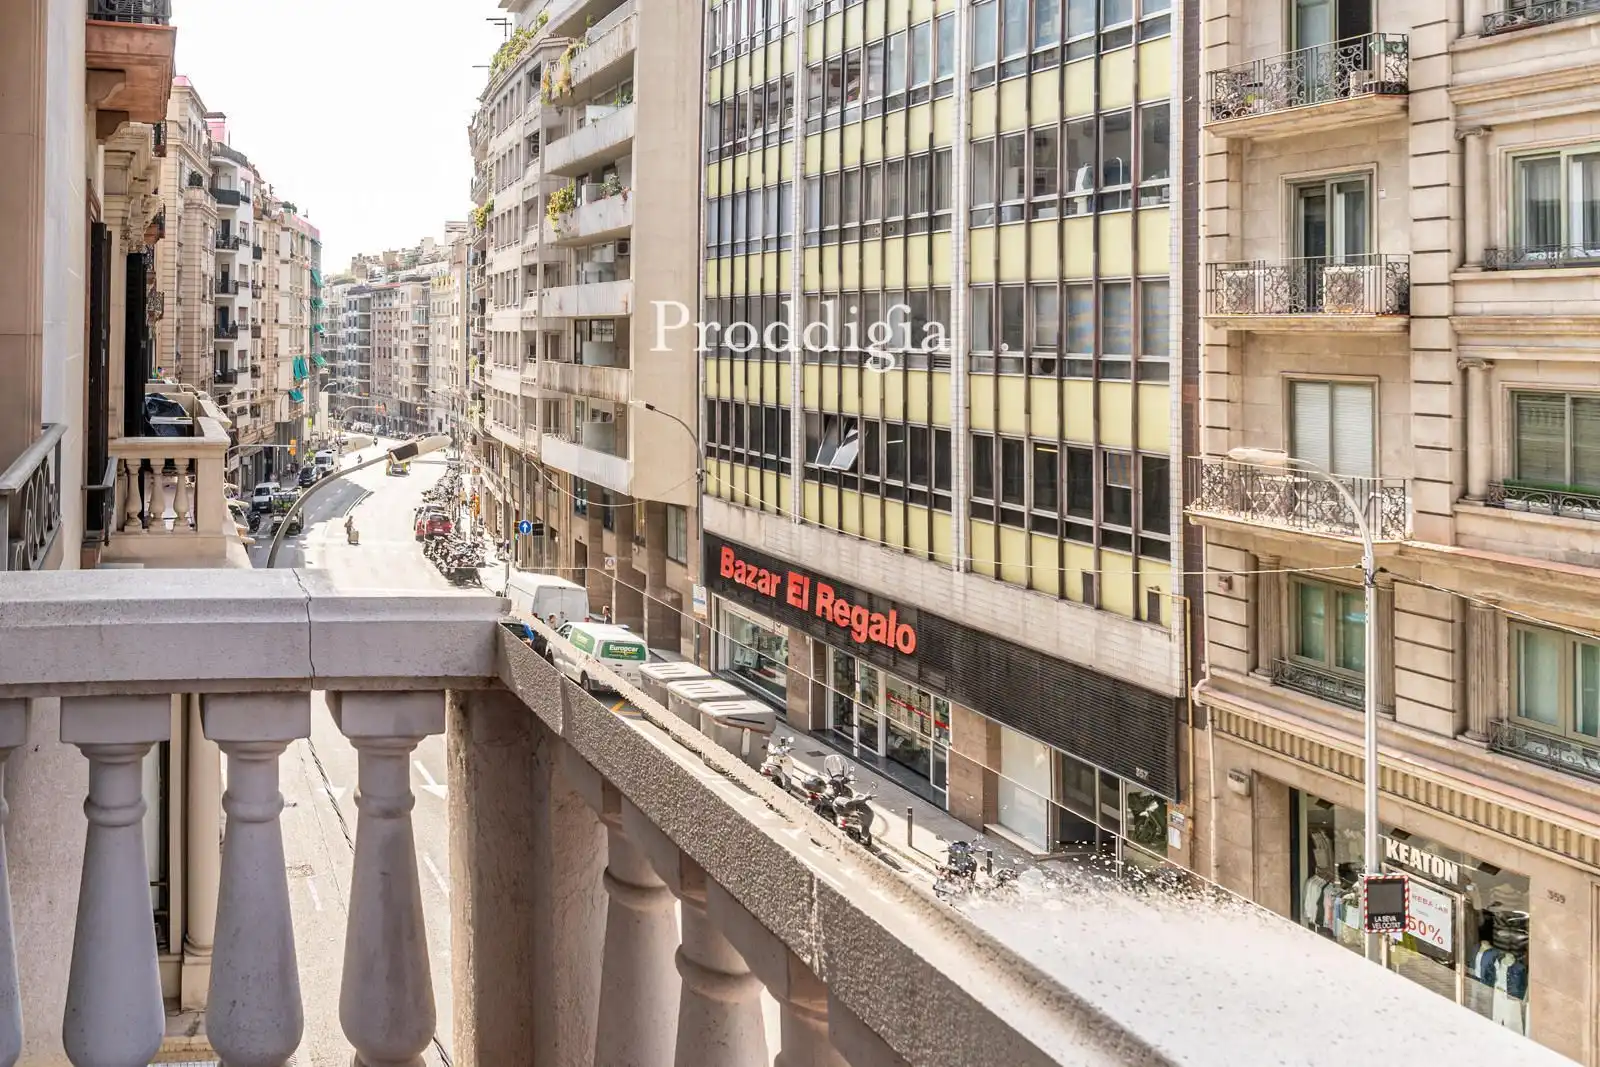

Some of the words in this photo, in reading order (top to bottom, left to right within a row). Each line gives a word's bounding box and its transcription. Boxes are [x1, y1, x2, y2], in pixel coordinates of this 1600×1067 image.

[720, 545, 782, 598] Bazar
[786, 571, 810, 611] El
[815, 582, 917, 655] Regalo
[609, 644, 639, 654] Europcar
[1385, 836, 1459, 886] KEATON
[1374, 915, 1382, 923] LA
[1382, 914, 1397, 923] SEVA
